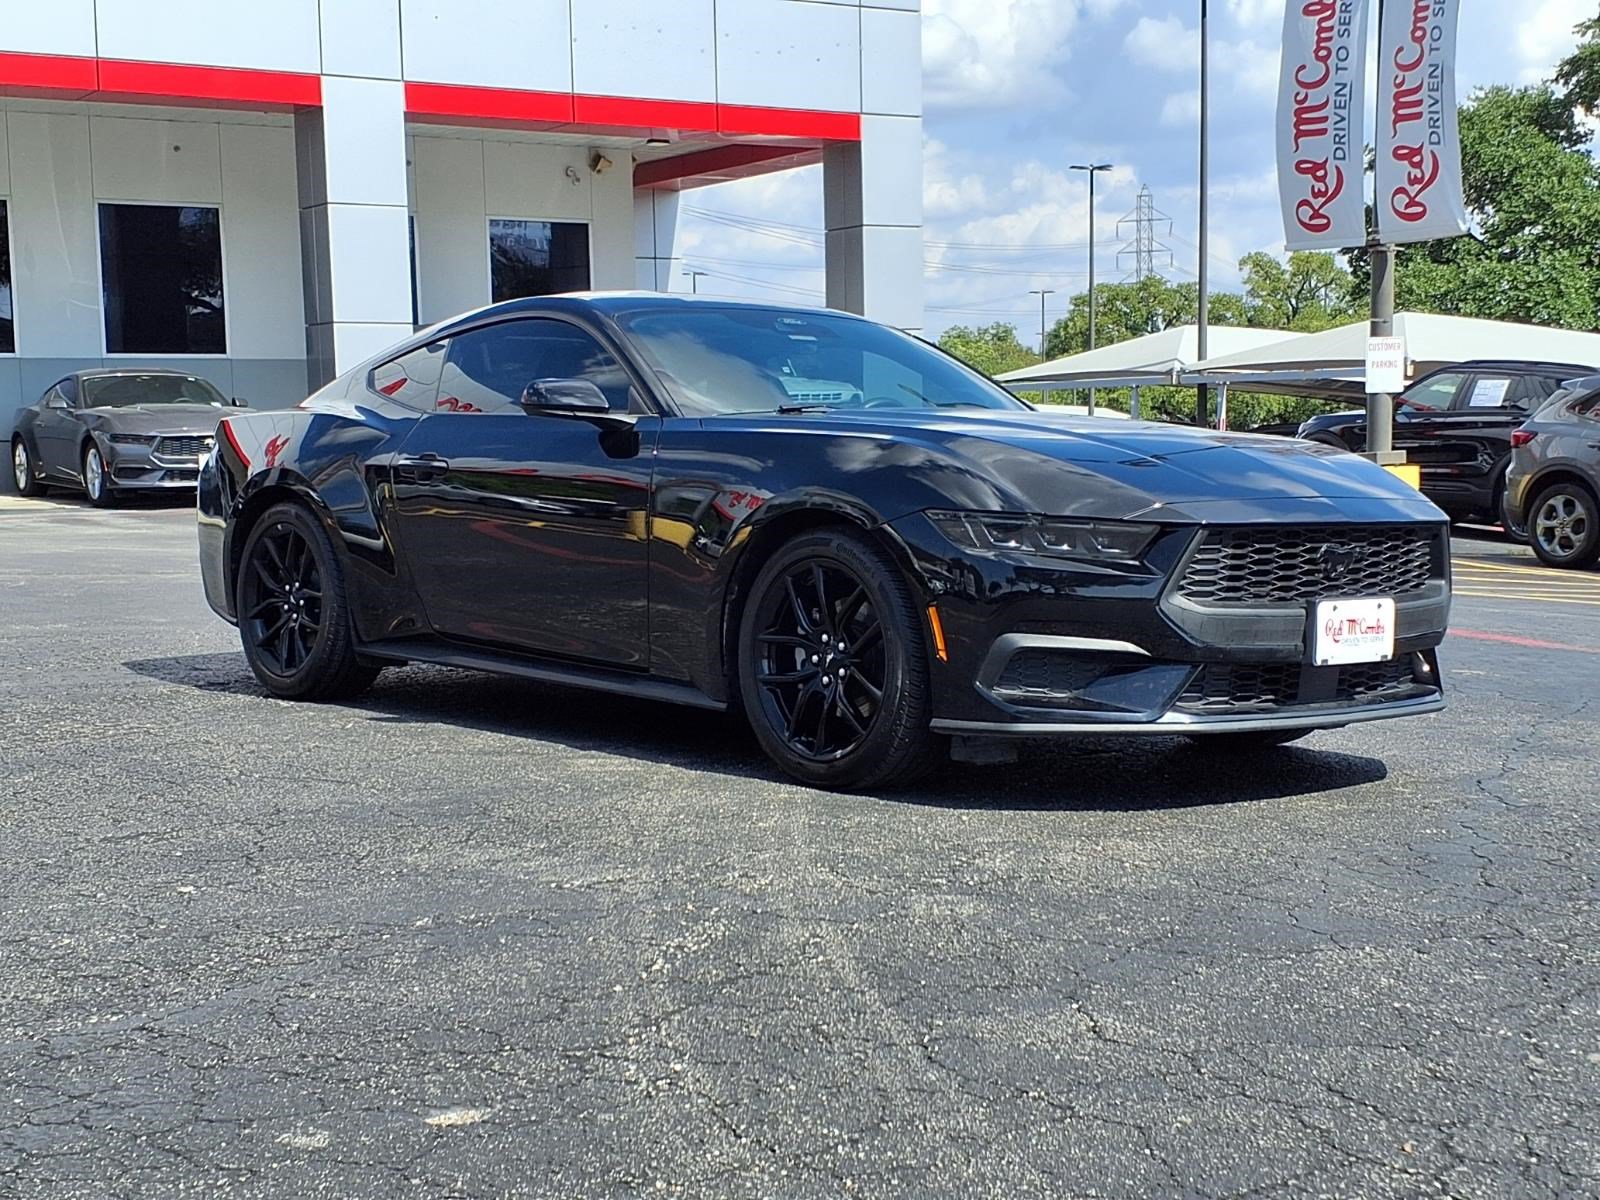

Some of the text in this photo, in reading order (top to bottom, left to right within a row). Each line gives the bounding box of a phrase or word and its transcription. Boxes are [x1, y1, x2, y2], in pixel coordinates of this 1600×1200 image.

[1429, 28, 1442, 56] TO
[1333, 0, 1353, 161] DRIVEN TO SER
[1428, 63, 1441, 146] DRIVEN
[1296, 157, 1344, 233] Red
[1391, 142, 1440, 222] Red
[1369, 343, 1401, 351] CUSTOMER
[1372, 360, 1397, 368] PARKING
[1325, 619, 1343, 643] Red
